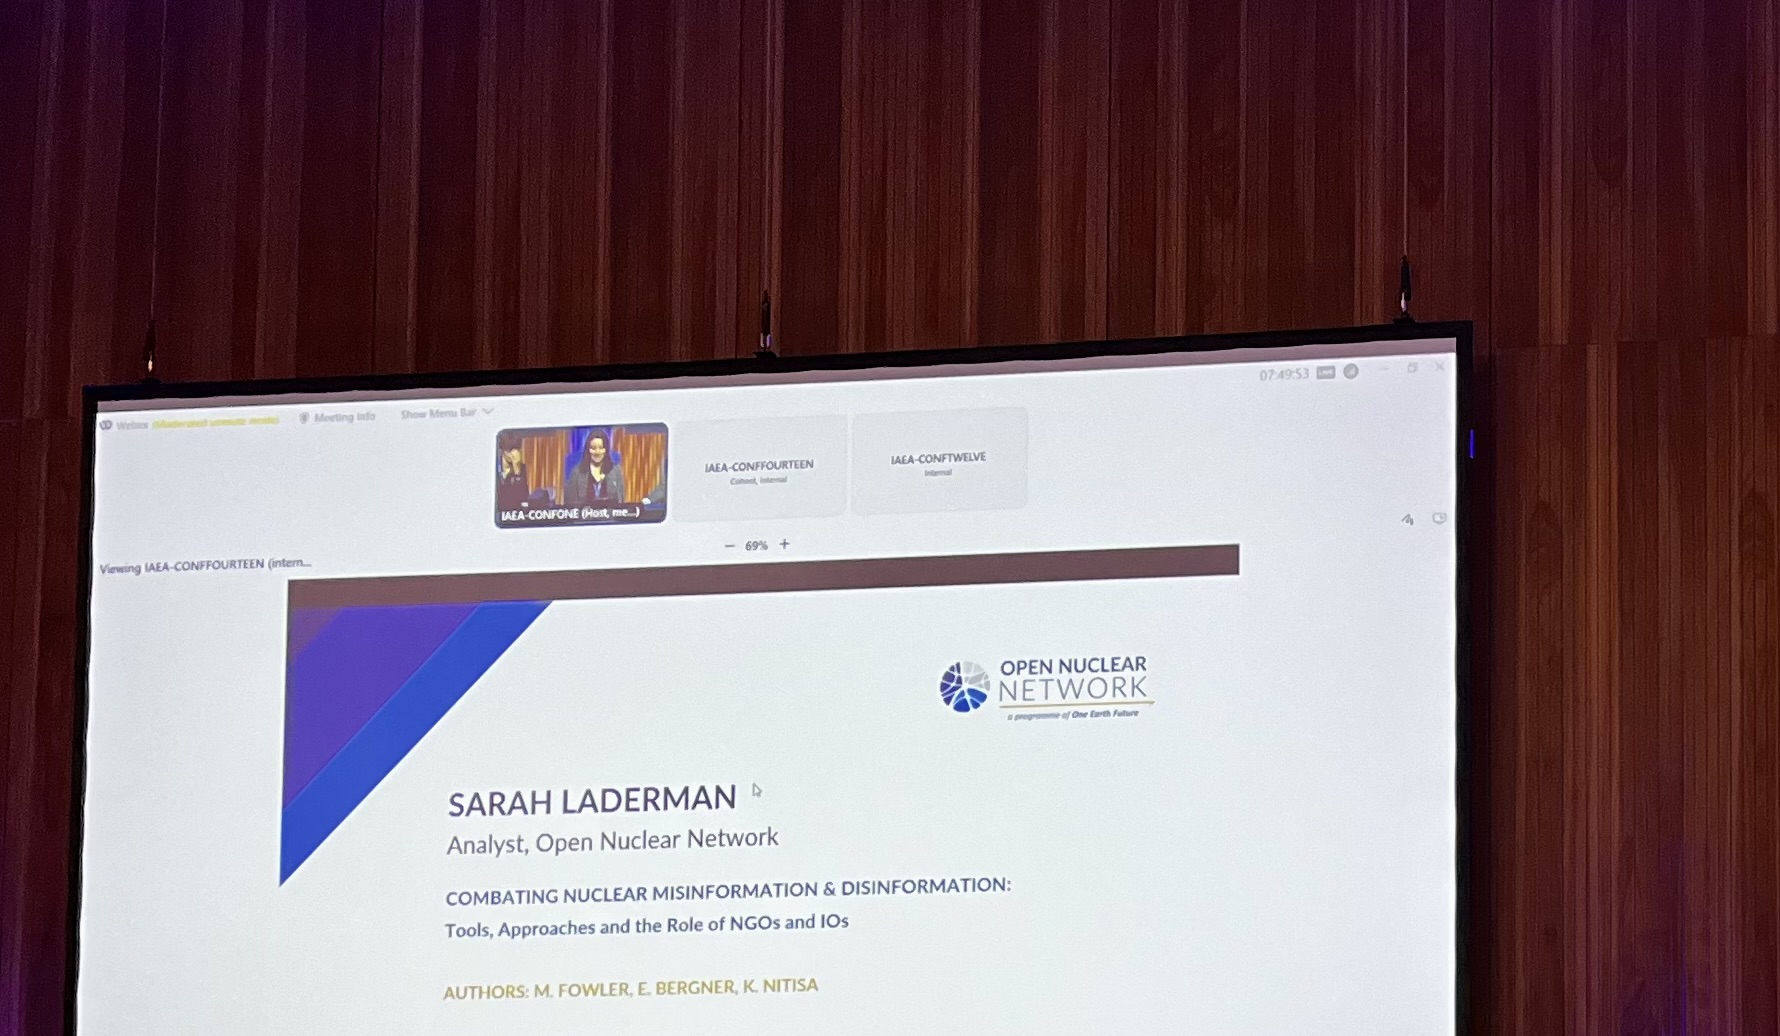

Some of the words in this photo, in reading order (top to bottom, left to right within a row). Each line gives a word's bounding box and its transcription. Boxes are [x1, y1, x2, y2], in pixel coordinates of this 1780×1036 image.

[1260, 368, 1309, 381] 07:49:53
[705, 459, 813, 472] IAEA-CONFFOURTEEN
[891, 452, 986, 464] IAEA-CONFTWELVE
[502, 508, 579, 520] IAEA-CONFONE
[582, 509, 609, 519] (Host,
[612, 507, 640, 517] me...)
[745, 541, 768, 551] 69%
[100, 564, 141, 576] Viewing
[145, 559, 264, 572] IAEA-CONFFOURTEEN
[1001, 659, 1052, 675] OPEN
[1059, 656, 1146, 674] NUCLEAR
[1000, 676, 1146, 701] NETWORK
[449, 790, 551, 817] SARAH
[563, 785, 735, 814] LADERMAN
[447, 834, 528, 857] Analyst,
[536, 834, 592, 856] Open
[601, 830, 681, 850] Nuclear
[688, 826, 778, 848] Network
[446, 889, 558, 906] COMBATING
[564, 887, 647, 903] NUCLEAR
[653, 882, 817, 900] MISINFORMATION
[824, 882, 836, 896] &
[842, 878, 1011, 895] DISINFORMATION:
[445, 922, 493, 938] Tools,
[498, 920, 595, 939] Approaches
[600, 919, 630, 934] and
[636, 918, 661, 933] the
[668, 917, 703, 932] Role
[708, 917, 725, 931] of
[731, 916, 780, 930] NGOs
[785, 914, 815, 929] and
[821, 914, 848, 928] IOs
[443, 985, 529, 1000] AUTHORS:
[535, 984, 552, 997] M.
[559, 982, 633, 997] FOWLER,
[638, 982, 650, 996] E.
[656, 980, 738, 995] BERGNER,
[744, 980, 758, 993] K.
[764, 978, 818, 992] NITISA
